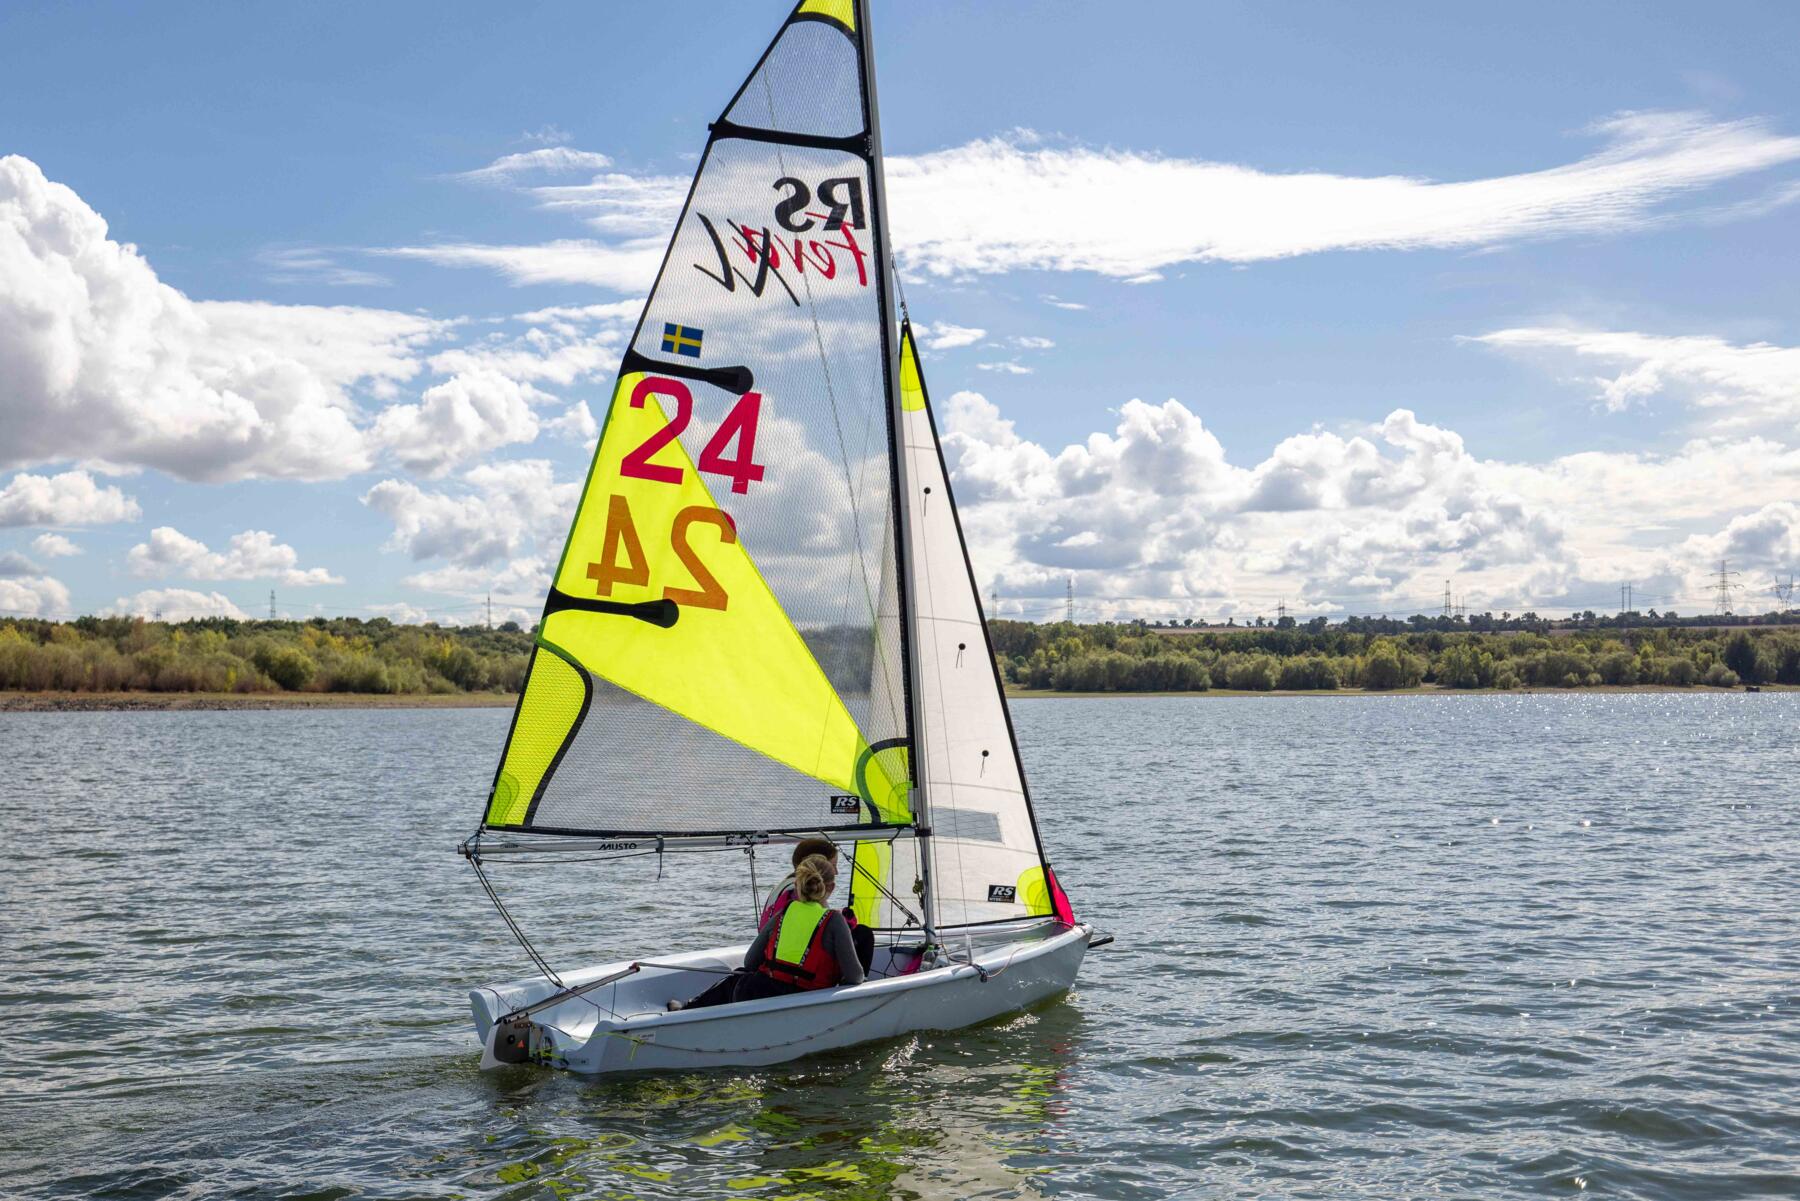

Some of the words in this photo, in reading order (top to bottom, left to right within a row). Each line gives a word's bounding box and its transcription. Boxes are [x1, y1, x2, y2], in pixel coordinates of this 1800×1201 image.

[620, 376, 765, 494] 24
[835, 796, 858, 807] RS
[598, 842, 637, 851] MUSTO
[992, 886, 1014, 896] RS
